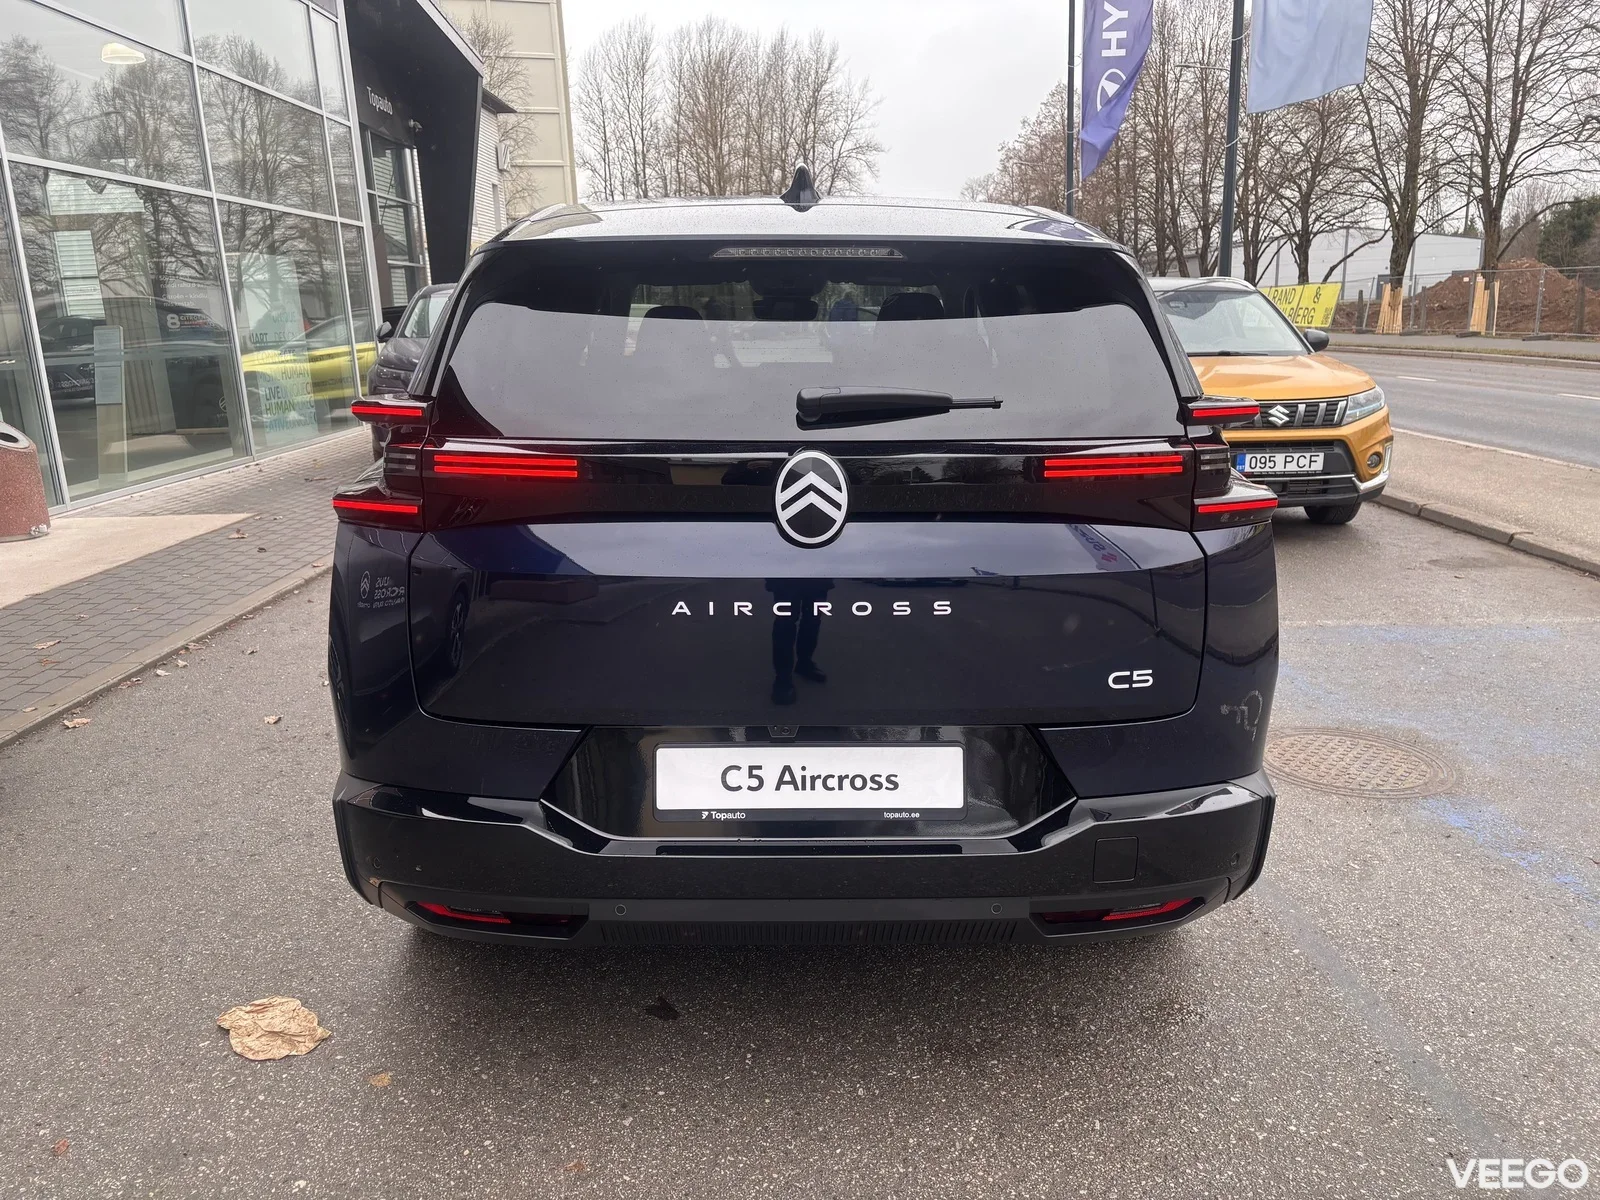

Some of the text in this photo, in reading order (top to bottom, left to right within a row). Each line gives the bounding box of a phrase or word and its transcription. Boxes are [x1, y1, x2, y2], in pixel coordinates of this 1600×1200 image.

[1101, 3, 1129, 57] HY
[366, 86, 393, 115] Topauto
[1249, 455, 1277, 470] 095
[1283, 454, 1321, 470] PCF
[671, 600, 953, 617] AIRCROSS
[1107, 669, 1154, 690] C5
[720, 764, 900, 792] C5 Aircross
[710, 810, 746, 821] Topauto
[883, 811, 920, 820] topauto.ee
